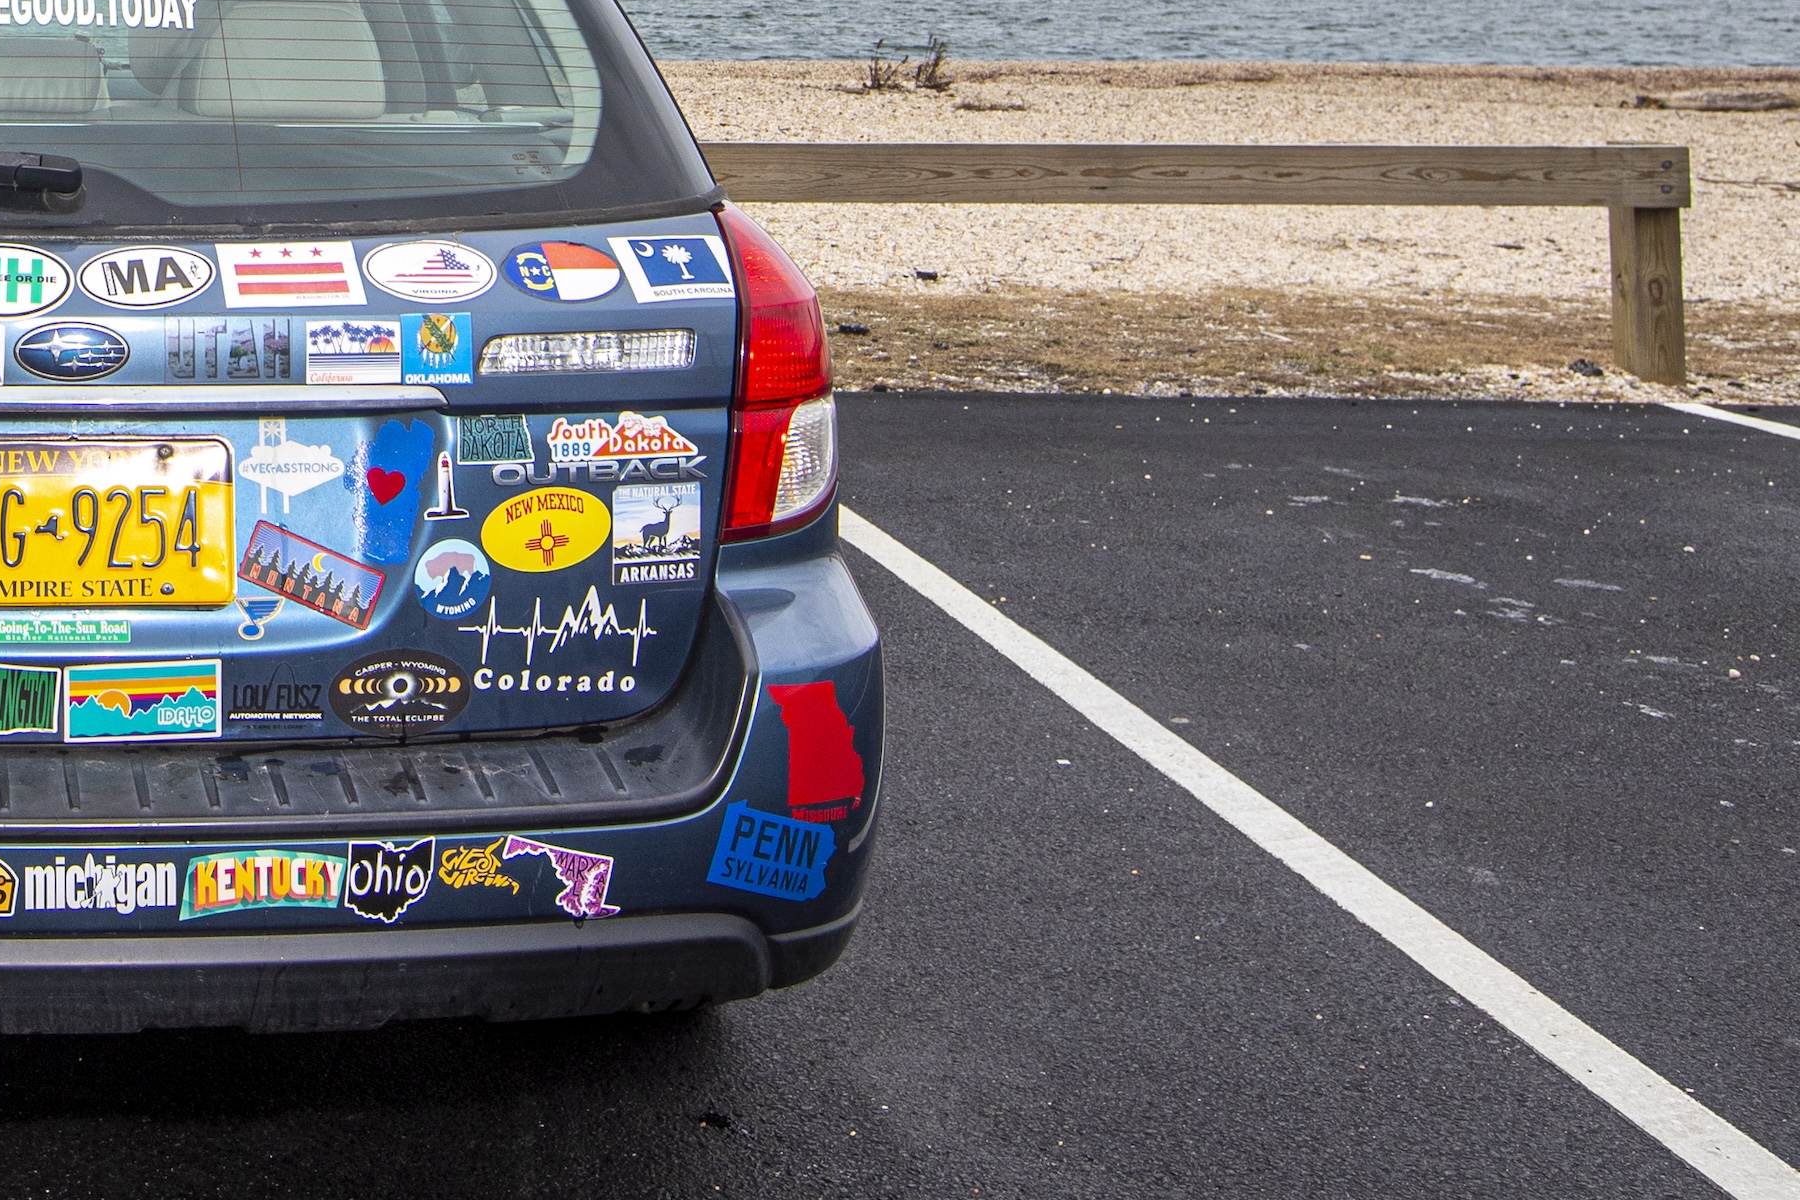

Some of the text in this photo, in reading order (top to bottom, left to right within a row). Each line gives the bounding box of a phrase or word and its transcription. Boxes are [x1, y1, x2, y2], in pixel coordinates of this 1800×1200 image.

[15, 275, 33, 283] OR
[36, 275, 57, 283] DIE
[101, 256, 194, 296] MA
[653, 287, 733, 297] SOUTH CAROLINA
[167, 318, 292, 380] UTAH
[310, 372, 353, 383] California
[405, 373, 471, 384] OKLAHOMA
[460, 415, 523, 433] NORTH
[551, 421, 611, 441] South
[460, 431, 528, 460] DAKOTA
[552, 442, 591, 457] 1889
[610, 432, 685, 453] Dakota
[68, 449, 150, 474] YO
[242, 463, 340, 474] #VEGASSTRONG
[492, 456, 708, 486] OUTBACK
[618, 484, 696, 499] THE NATURAL STATE
[505, 494, 584, 524] NEW MEXICO
[72, 487, 201, 568] 9254
[620, 563, 695, 583] ARKANSAS
[81, 578, 153, 596] STATE
[250, 563, 359, 622] MONTANA
[436, 597, 477, 615] WYOMING
[100, 621, 128, 634] Road
[355, 661, 393, 677] CASPER
[400, 660, 446, 676] WYOMING
[473, 668, 636, 693] Colorado
[233, 684, 322, 711] LOU FUSZ
[157, 705, 215, 728] IDAHO
[229, 712, 323, 720] AUTOMOTIVE NETWORK
[373, 714, 402, 722] TOTAL
[405, 714, 445, 722] ECLIPSE
[731, 815, 821, 869] PENN
[24, 853, 177, 915] michigan
[194, 857, 343, 911] KENTUCKY
[350, 850, 426, 897] Ohio
[721, 857, 808, 895] SYLVANIA
